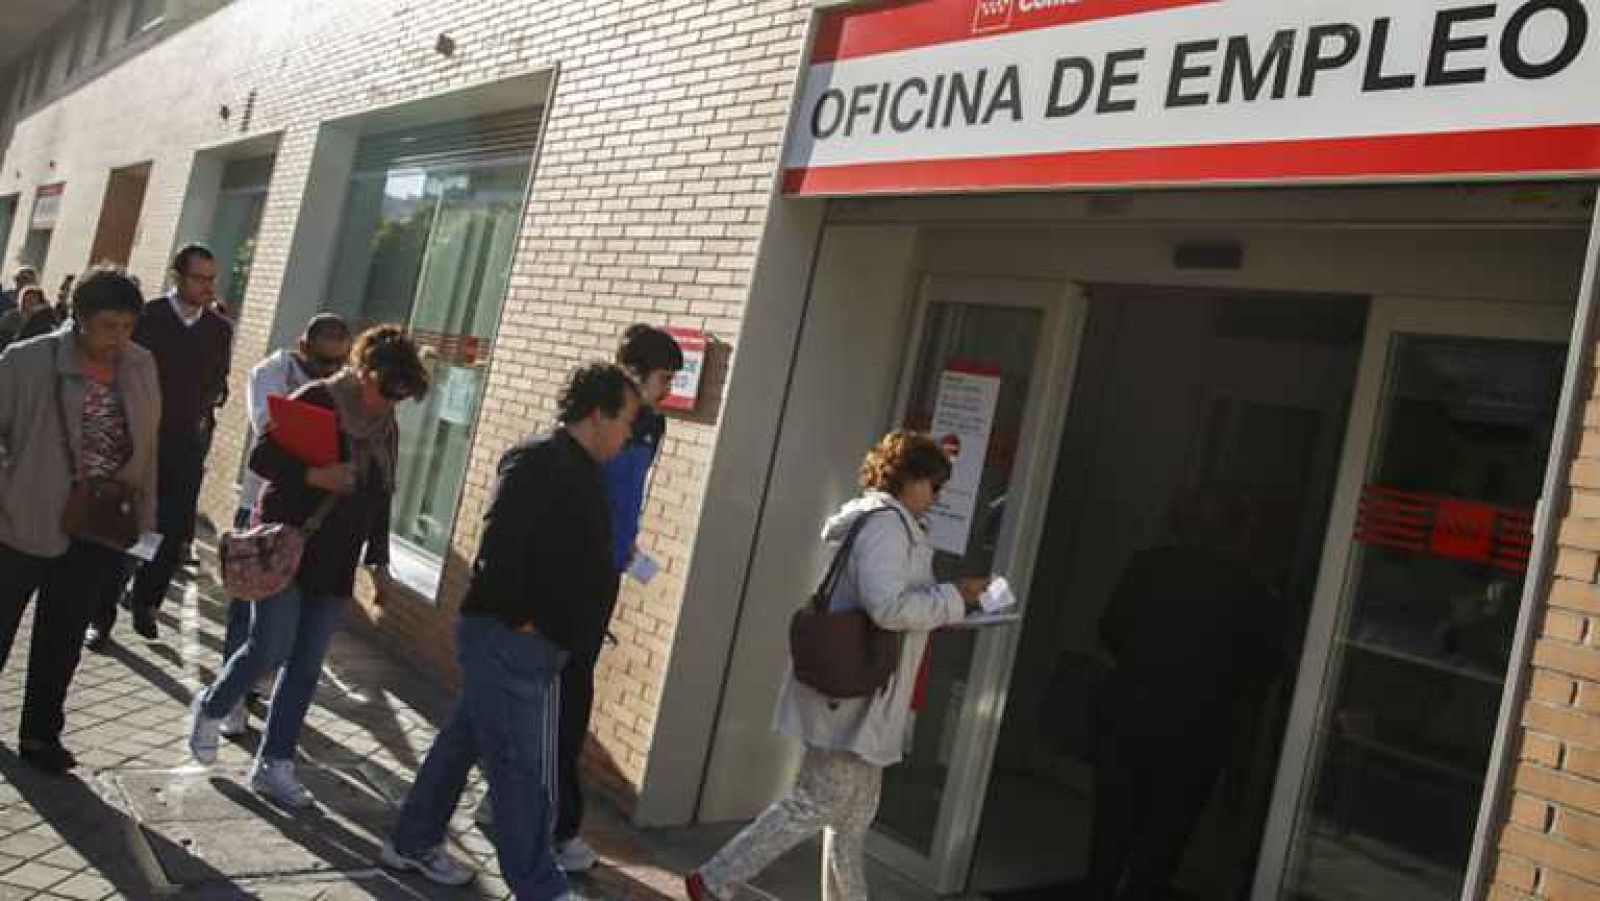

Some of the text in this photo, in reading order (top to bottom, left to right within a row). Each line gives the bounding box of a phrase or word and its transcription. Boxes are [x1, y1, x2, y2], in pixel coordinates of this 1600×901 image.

[810, 0, 1588, 139] OFICINA DE EMPLEO
